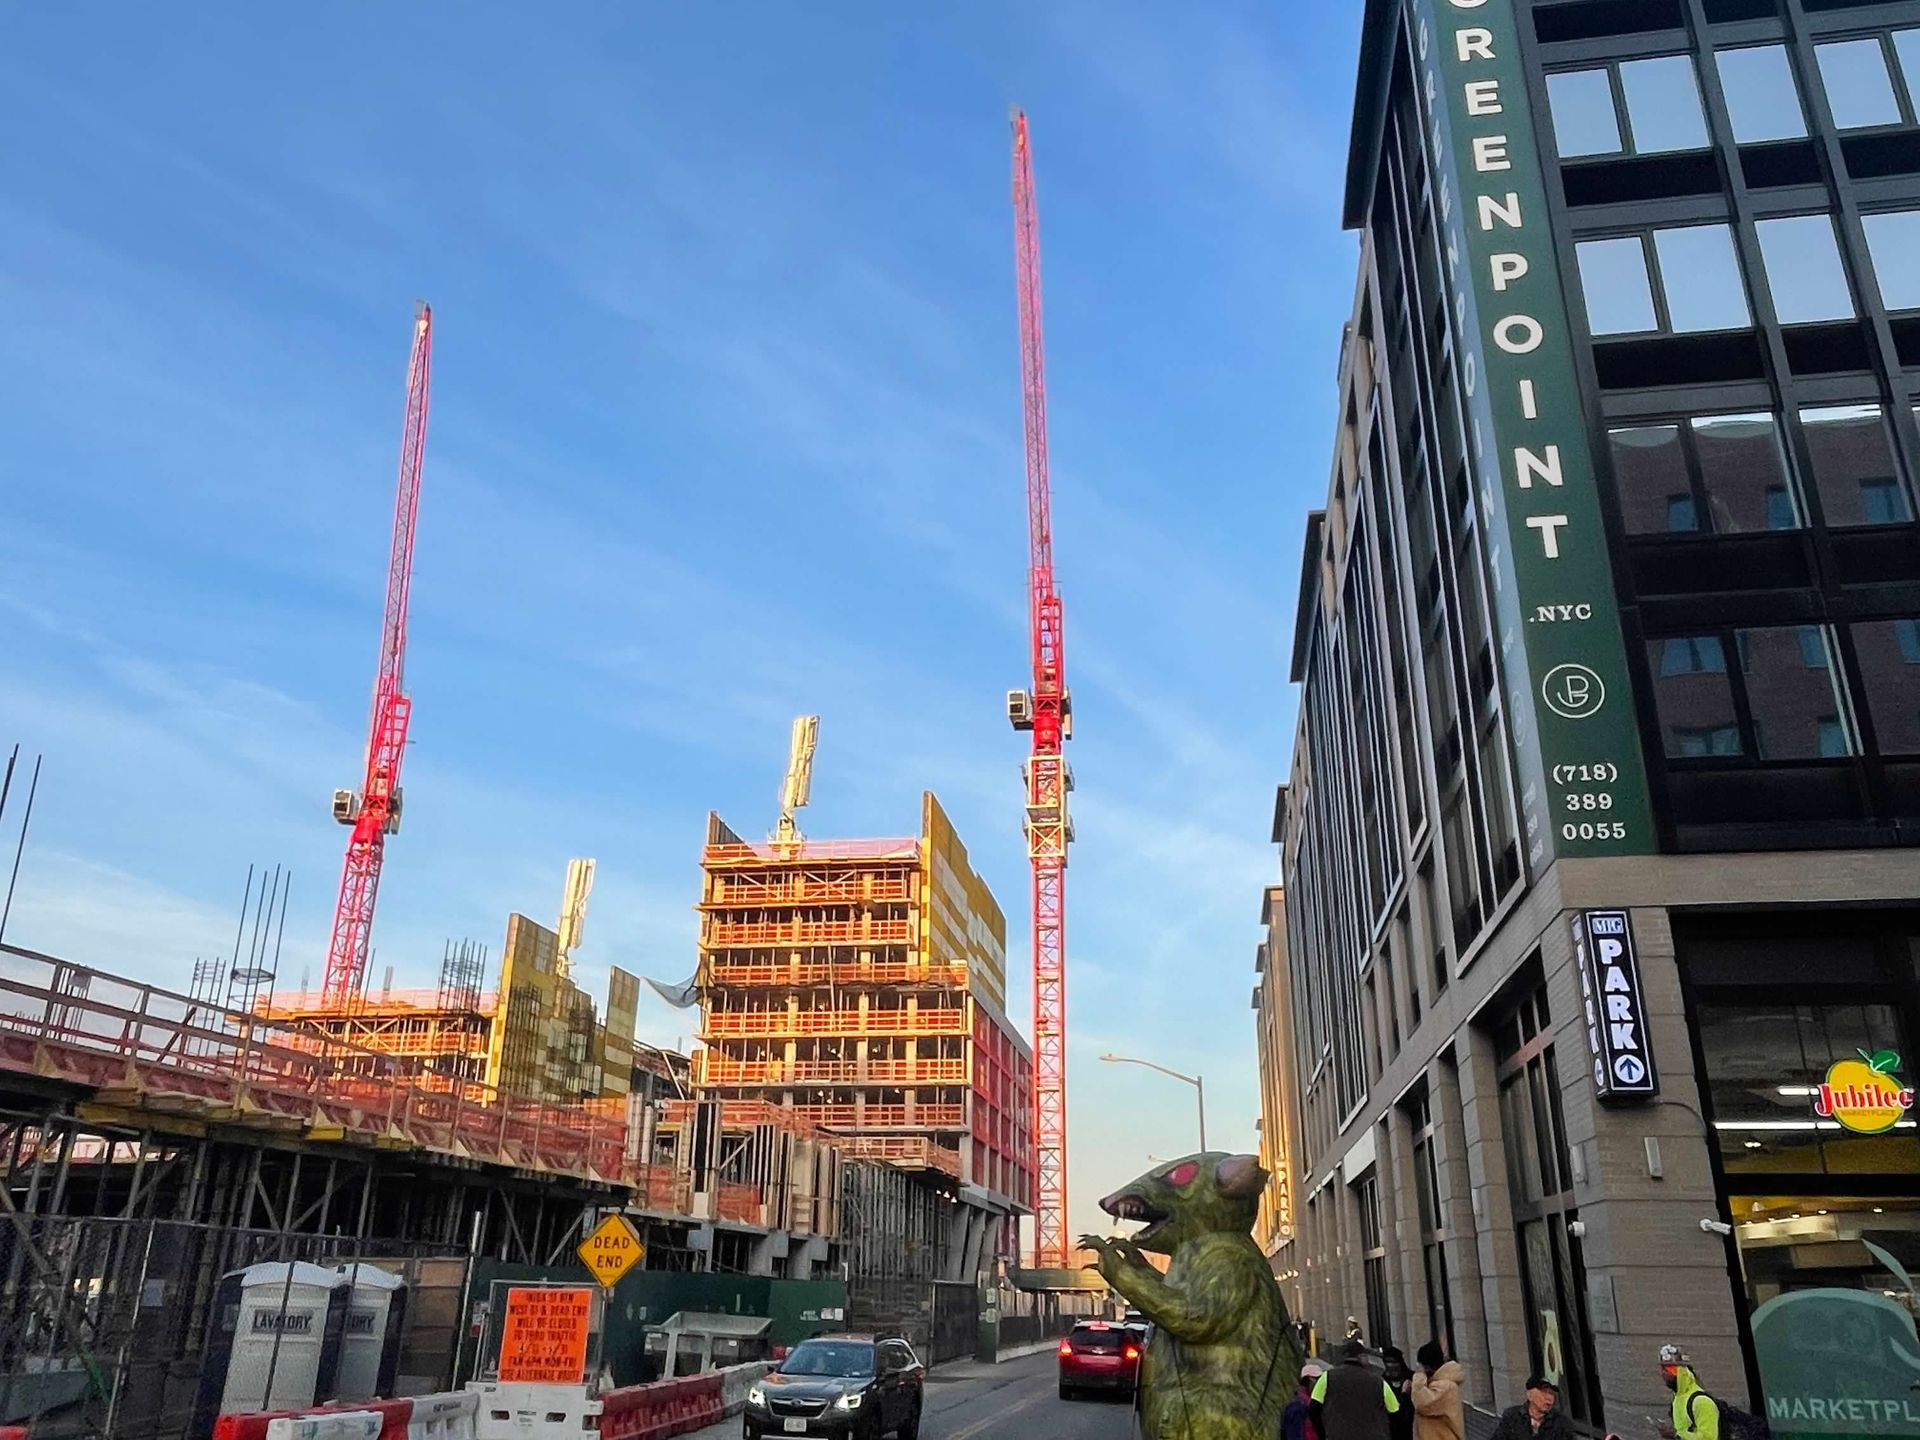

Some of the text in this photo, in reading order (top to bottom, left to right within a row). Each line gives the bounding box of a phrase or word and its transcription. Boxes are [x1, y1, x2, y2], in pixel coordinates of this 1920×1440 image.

[1448, 0, 1569, 559] REENPOINT
[1529, 603, 1592, 623] .NYC
[1553, 763, 1618, 785] (718)
[1566, 793, 1613, 811] 389
[1562, 822, 1626, 841] 0055
[1598, 939, 1638, 1050] PARK
[1814, 1083, 1914, 1117] Jubilee
[594, 1236, 630, 1248] DEAD
[596, 1255, 623, 1268] END
[253, 1313, 312, 1329] LAVATORY
